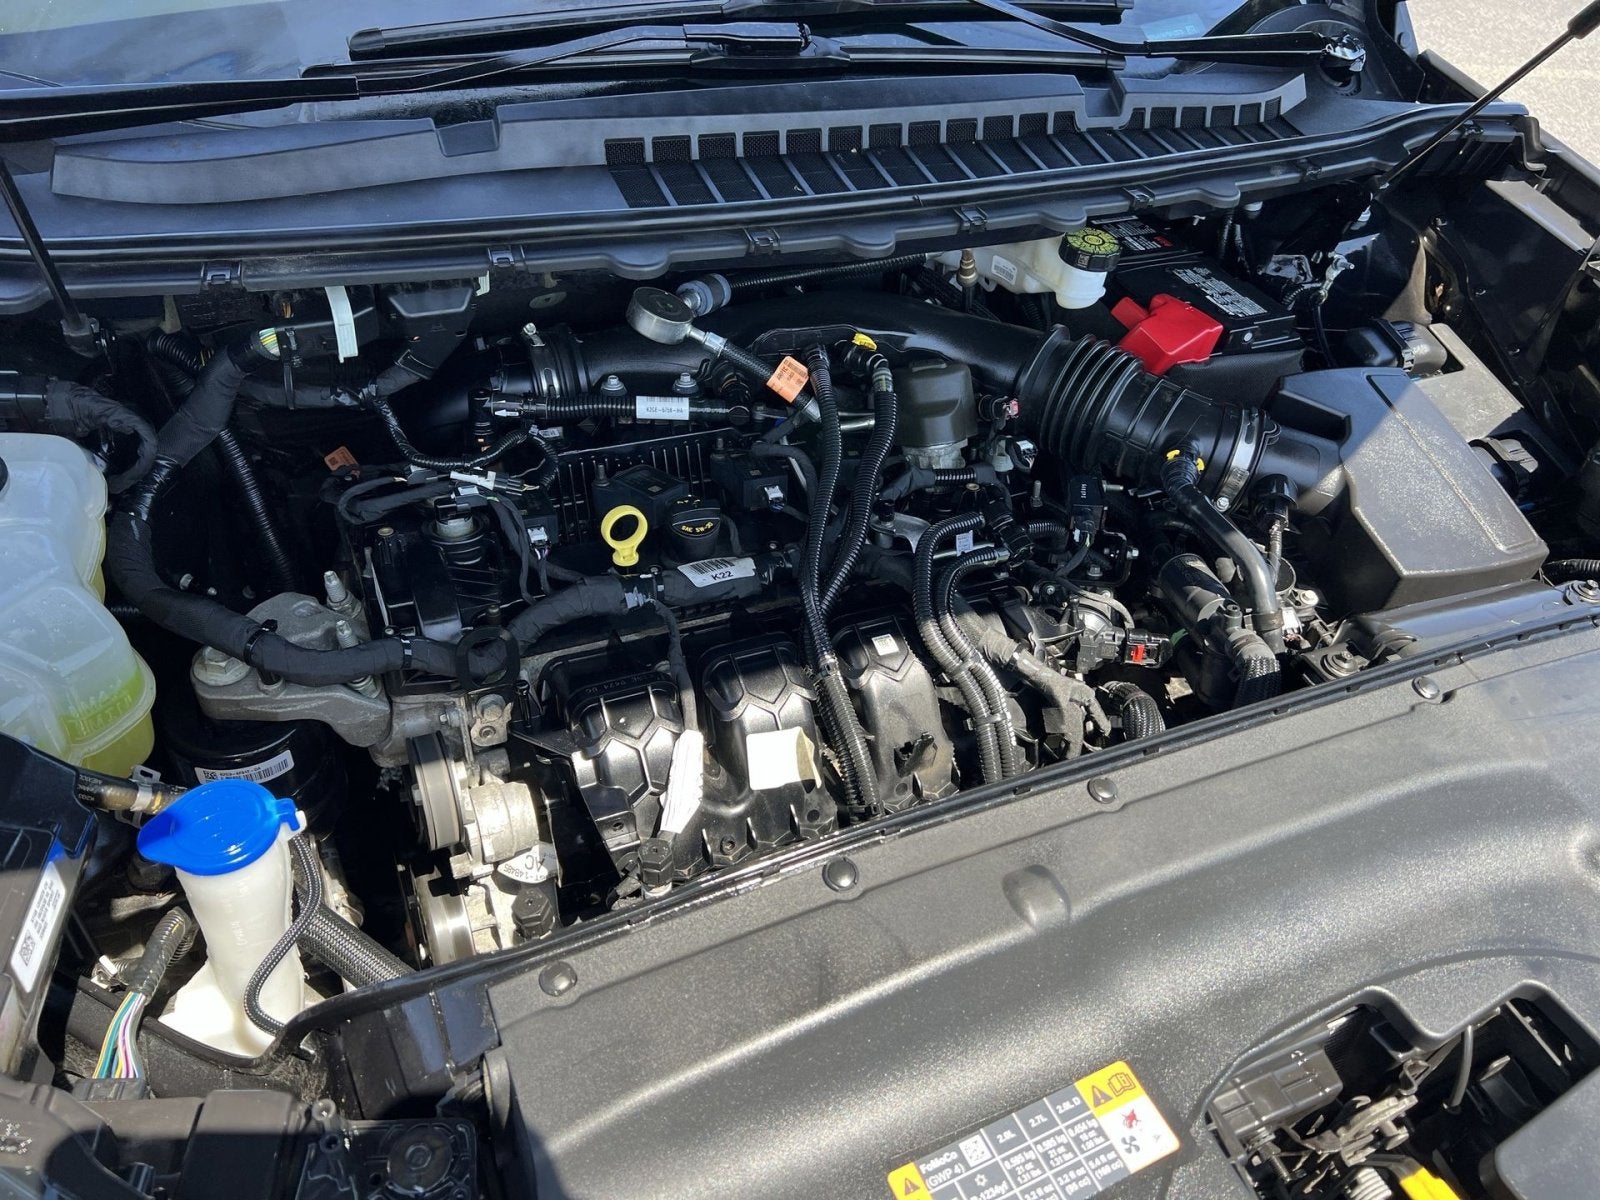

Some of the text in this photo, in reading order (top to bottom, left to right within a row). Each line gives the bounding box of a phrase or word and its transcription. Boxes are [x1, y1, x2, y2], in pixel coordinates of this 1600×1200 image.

[681, 525, 693, 533] SAE
[711, 570, 734, 581] K22
[525, 855, 545, 872] AC
[1072, 1096, 1081, 1106] D
[1028, 1114, 1048, 1128] 2.7L
[1086, 1118, 1099, 1129] kg
[1056, 1133, 1069, 1145] kg
[1023, 1149, 1036, 1161] kg
[919, 1151, 958, 1174] FoMoCo
[926, 1163, 965, 1189] (GWP 4)
